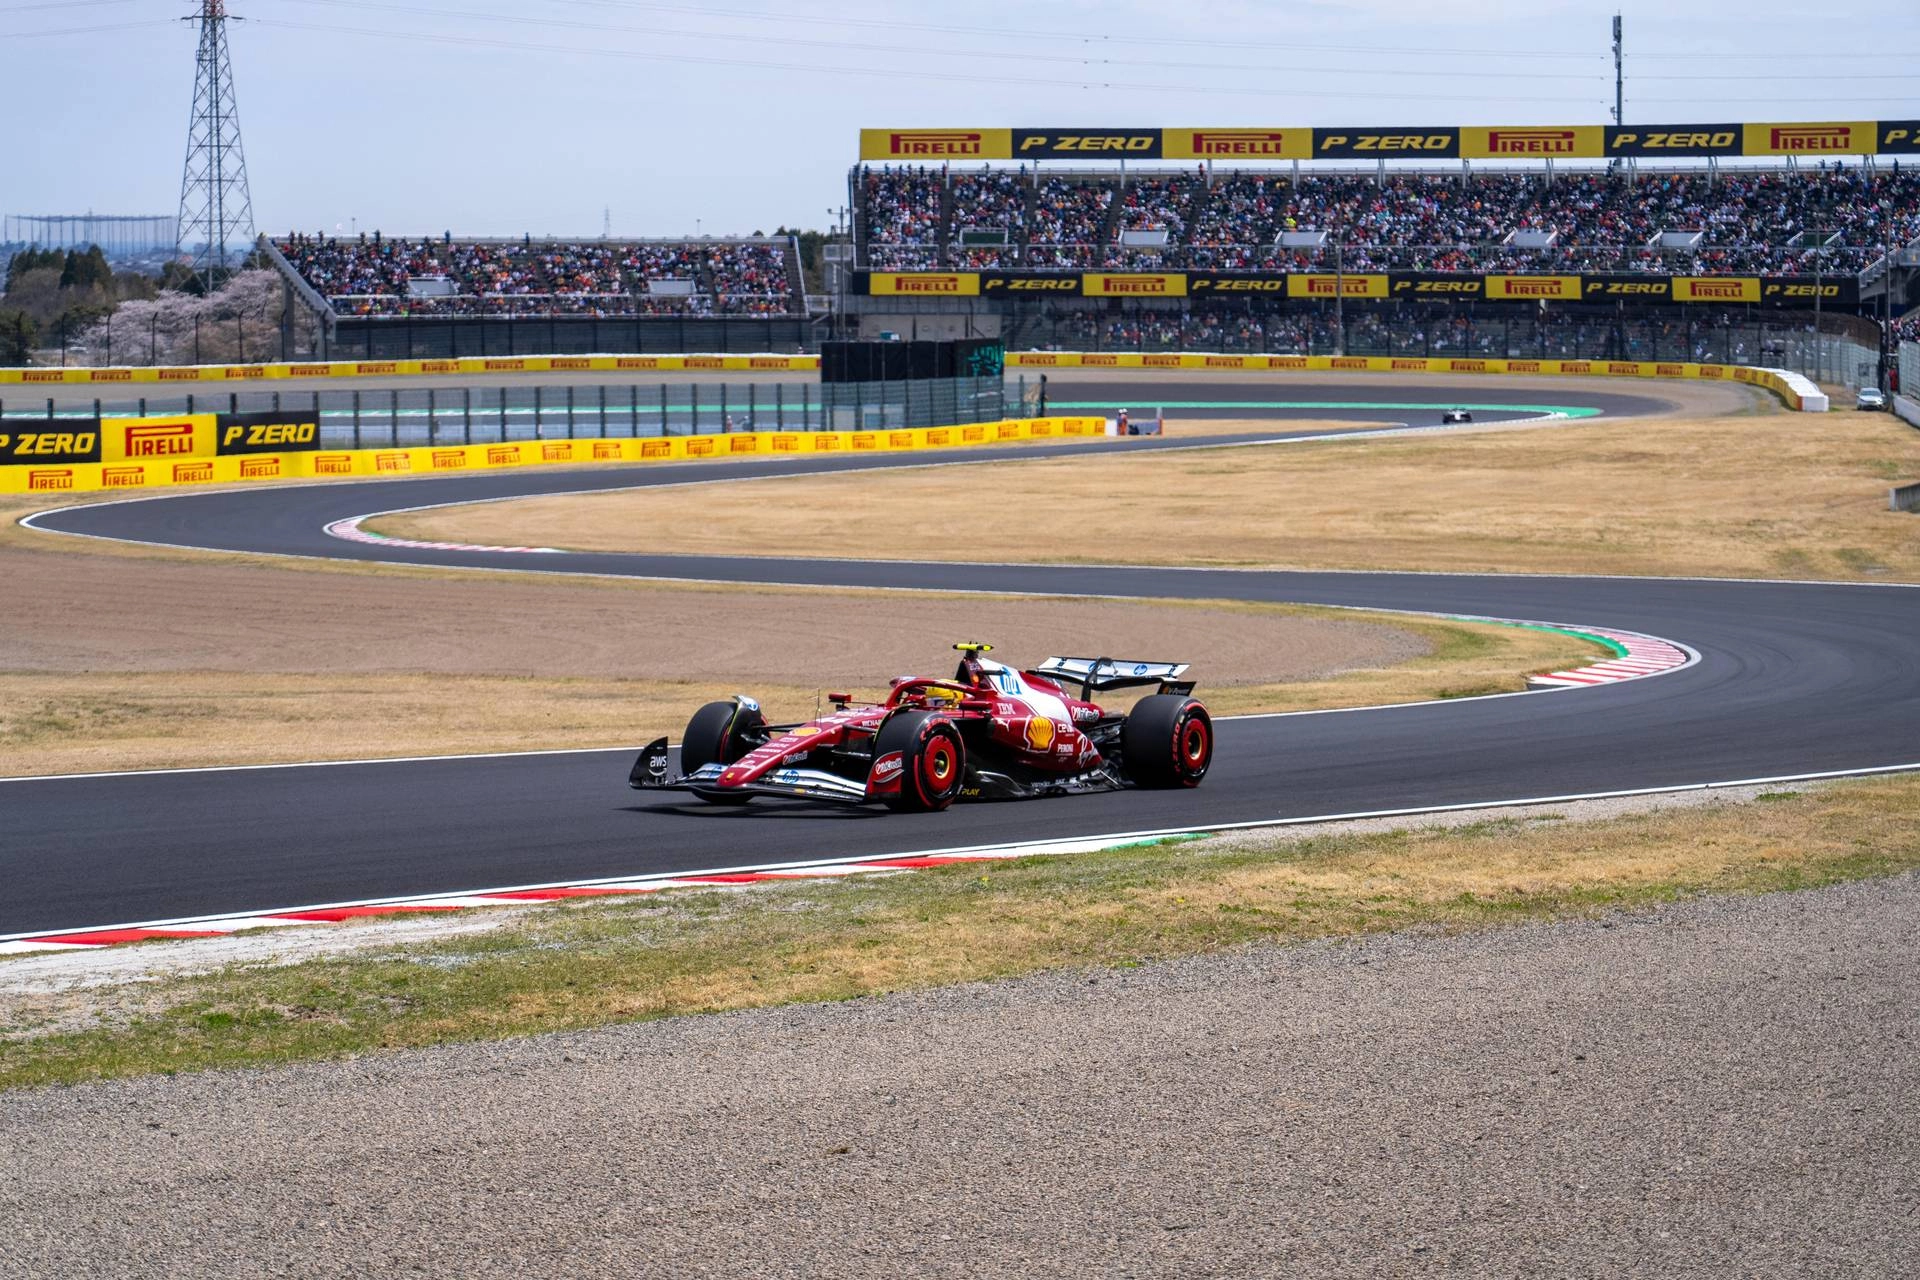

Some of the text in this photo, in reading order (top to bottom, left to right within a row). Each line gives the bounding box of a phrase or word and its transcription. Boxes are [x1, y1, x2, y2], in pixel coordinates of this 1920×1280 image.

[890, 134, 981, 154] PIRELLI
[1020, 136, 1154, 150] P ZERO
[1193, 133, 1282, 154] PIRELLI
[1321, 135, 1451, 150] P ZERO
[1489, 131, 1575, 152] PIRELLI
[1612, 132, 1735, 148] P ZERO
[1770, 127, 1850, 150] PIRELLI
[1884, 130, 1908, 144] P
[895, 276, 959, 291] PIRELLI
[985, 279, 1077, 290] P ZERO
[1103, 277, 1166, 292] PIRELLI
[1192, 280, 1282, 291] P ZERO
[1308, 279, 1368, 293] PIRLLI
[1394, 281, 1480, 292] P ZERO
[1505, 279, 1561, 294] PIRELLI
[1586, 282, 1667, 294] P ZERO
[1690, 281, 1743, 297] PIRELLI
[1765, 284, 1839, 296] P ZERO
[14, 433, 96, 455] ZERO
[125, 423, 193, 457] PIRELLI
[223, 423, 315, 447] P ZERO
[432, 450, 466, 468] PIRELLI
[487, 446, 521, 464] PIRELLI
[542, 443, 573, 461] PIRELLI
[240, 457, 281, 478] PIRELLI
[315, 455, 351, 473] PIRELLI
[376, 453, 411, 471] PIRELLI
[28, 469, 73, 489] PIRELLI
[102, 466, 145, 487] PIRELLI
[172, 462, 214, 482] PIRELLI
[650, 756, 667, 767] aws
